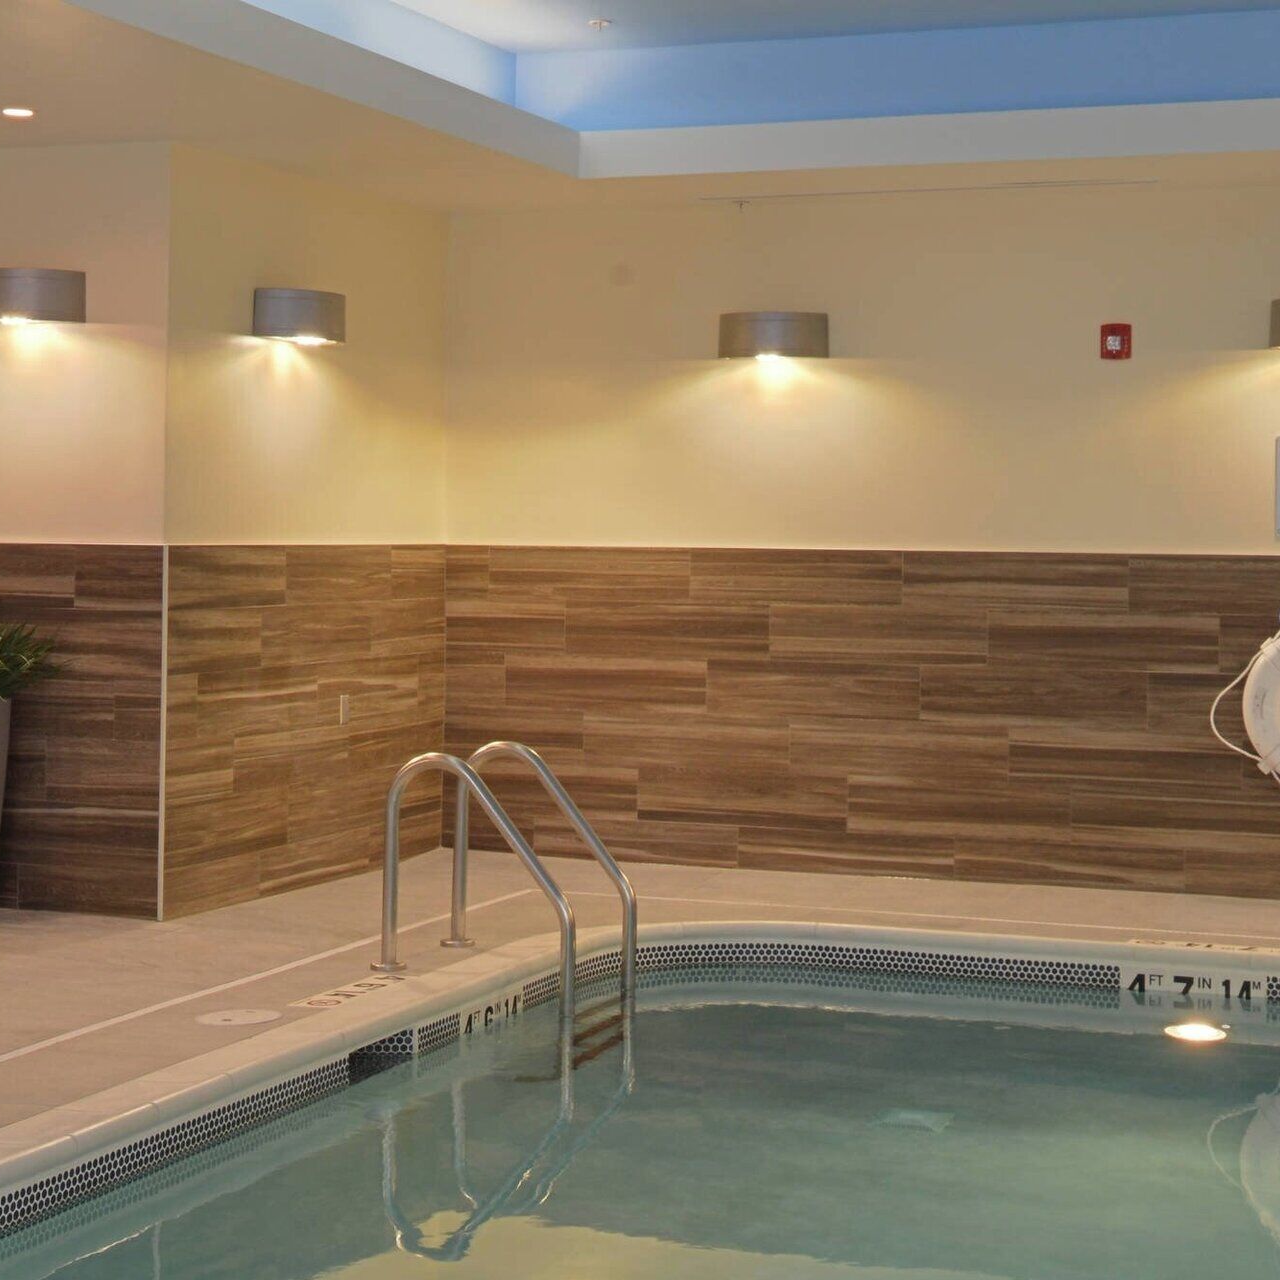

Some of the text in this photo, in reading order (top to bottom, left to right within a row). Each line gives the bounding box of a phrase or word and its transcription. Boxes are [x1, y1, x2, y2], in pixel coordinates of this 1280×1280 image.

[1149, 974, 1164, 986] FT
[1173, 975, 1195, 996] 7
[1197, 976, 1212, 989] IN
[1252, 981, 1261, 990] M
